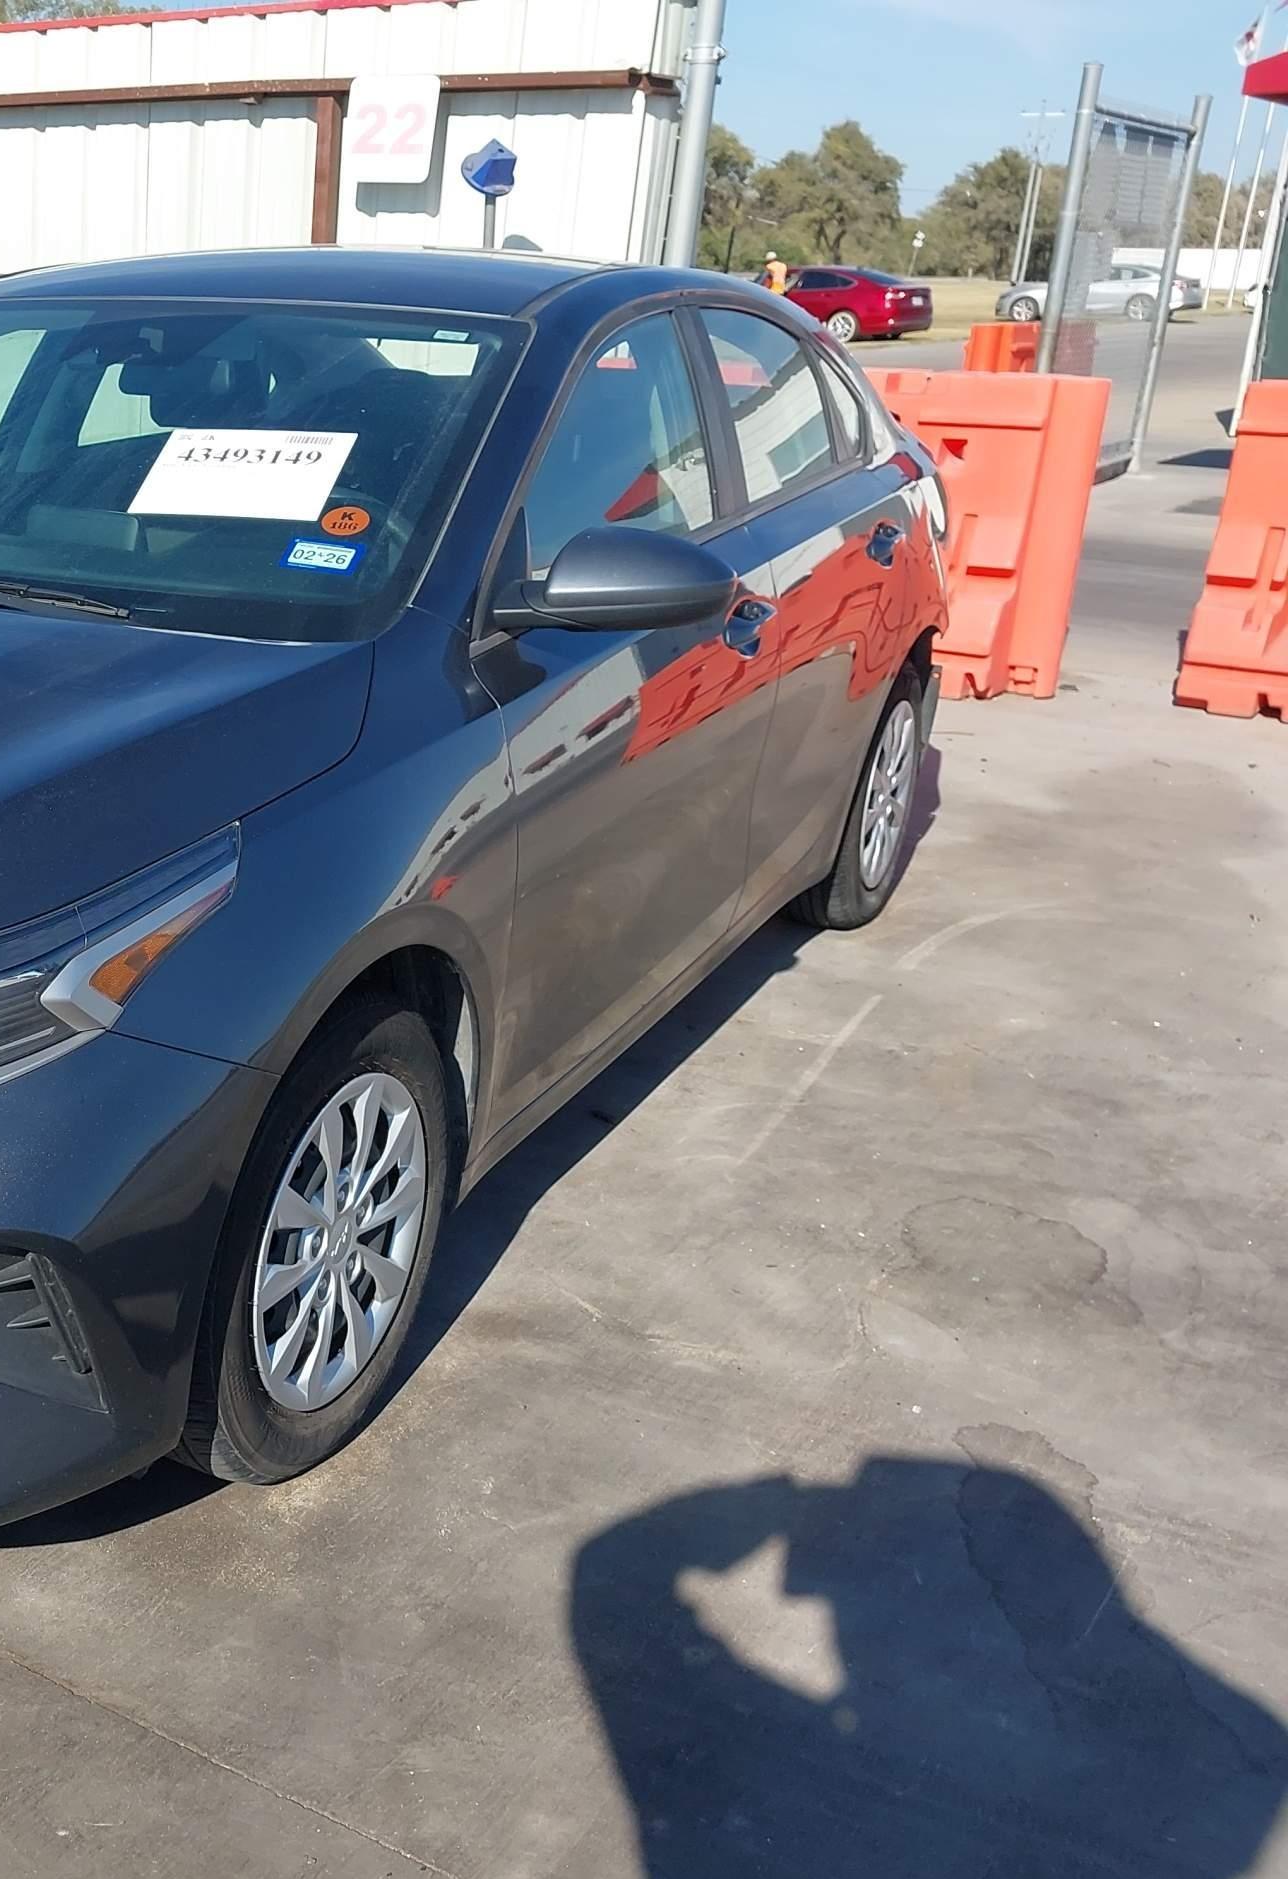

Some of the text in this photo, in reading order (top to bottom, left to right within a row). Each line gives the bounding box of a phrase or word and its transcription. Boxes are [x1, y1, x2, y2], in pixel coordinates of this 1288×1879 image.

[350, 103, 427, 155] 22
[177, 447, 323, 466] 43493149
[340, 511, 357, 522] K
